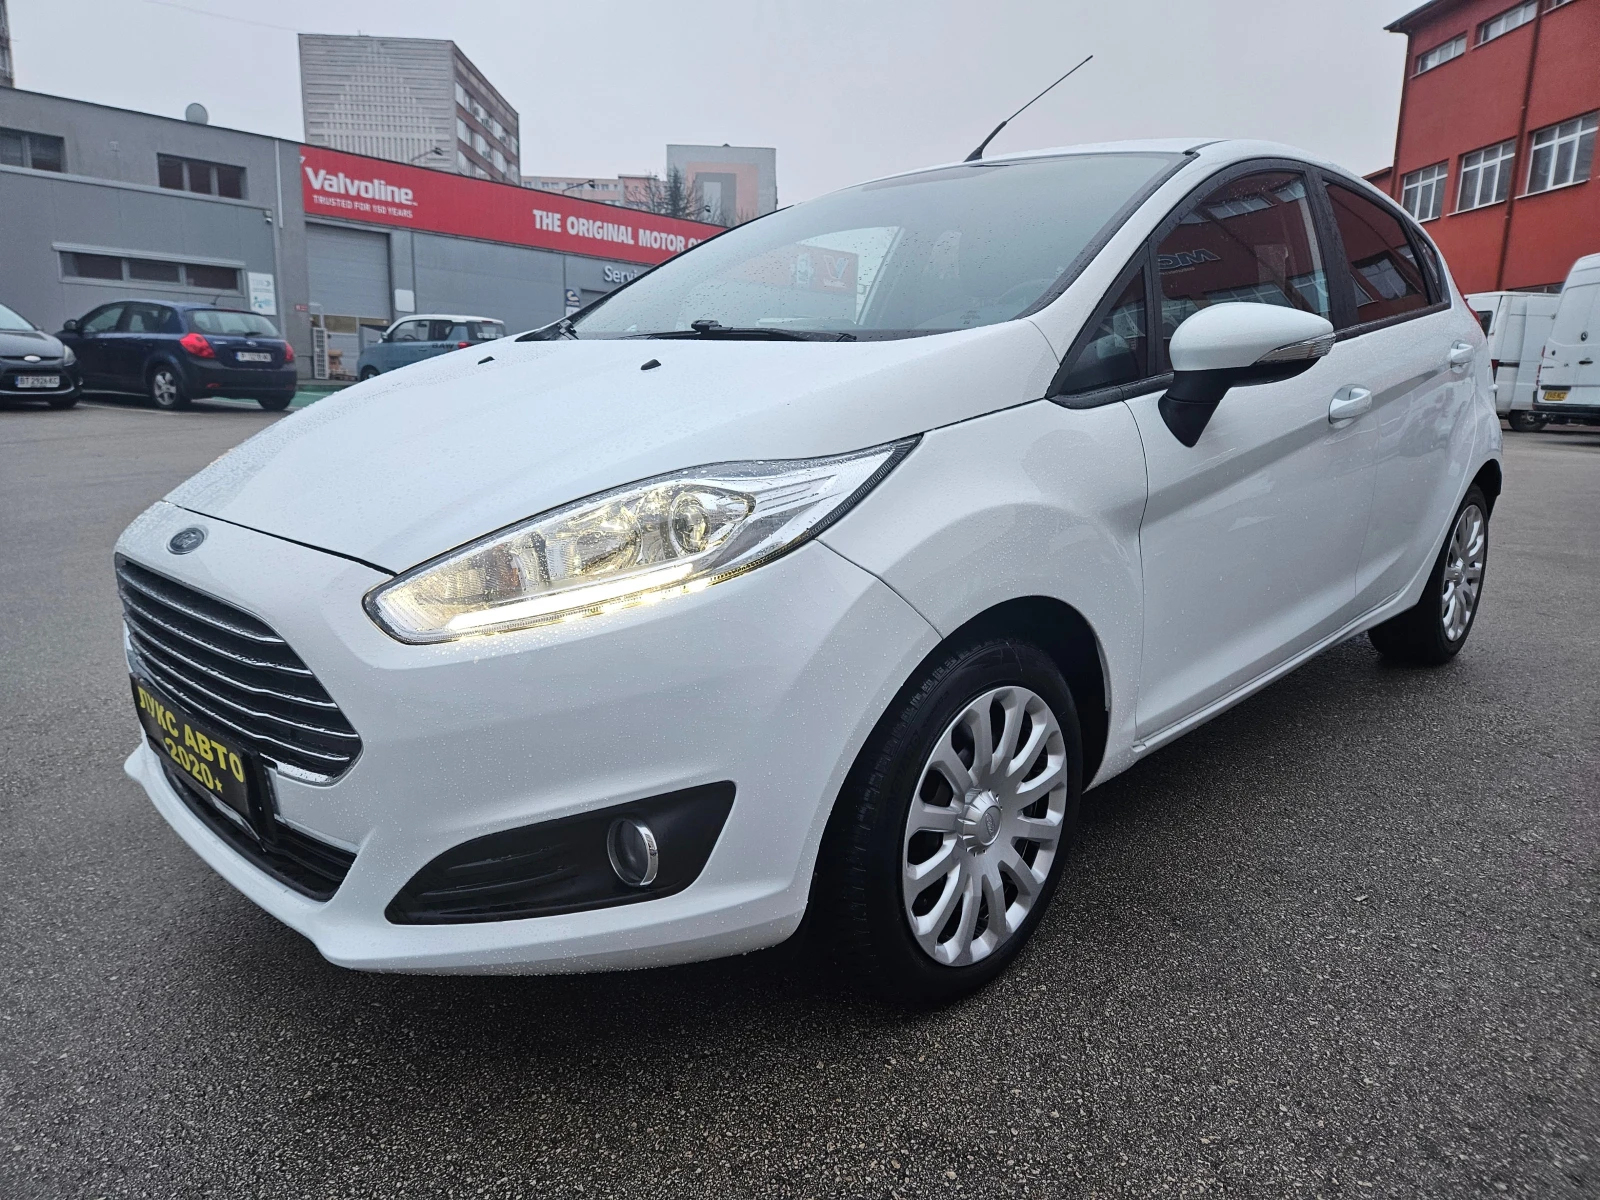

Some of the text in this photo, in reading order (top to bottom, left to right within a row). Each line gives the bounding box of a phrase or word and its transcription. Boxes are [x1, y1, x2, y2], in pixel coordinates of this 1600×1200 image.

[305, 166, 414, 206] Valvoline
[313, 195, 353, 209] TRUSTED
[354, 202, 371, 212] FOR
[388, 206, 413, 218] YEARS
[533, 209, 562, 233] THE
[566, 215, 634, 245] ORIGINAL
[638, 228, 685, 253] MOTOR
[137, 685, 244, 783] ЛУКС АВТО
[164, 737, 214, 790] 2020
